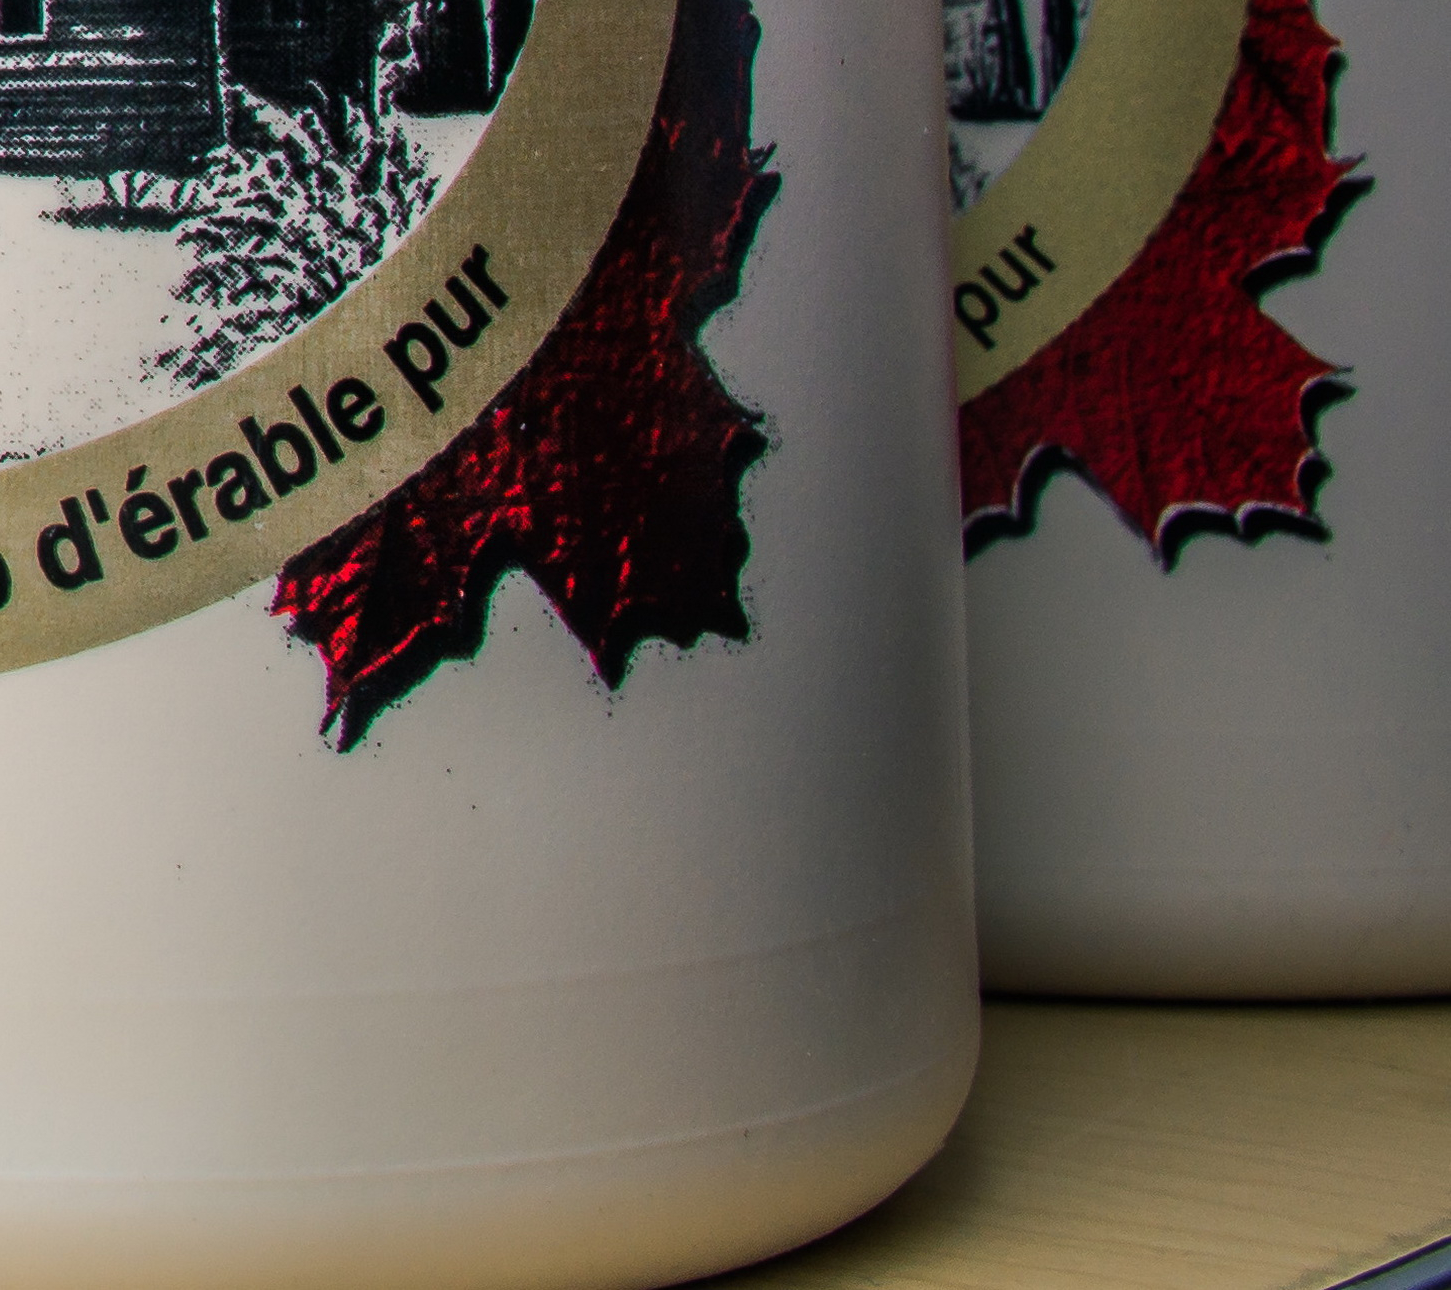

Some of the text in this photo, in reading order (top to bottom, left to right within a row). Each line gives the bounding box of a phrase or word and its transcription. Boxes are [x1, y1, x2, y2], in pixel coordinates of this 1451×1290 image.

[953, 220, 1060, 351] pur
[36, 375, 387, 593] d'érable
[382, 242, 511, 415] pur
